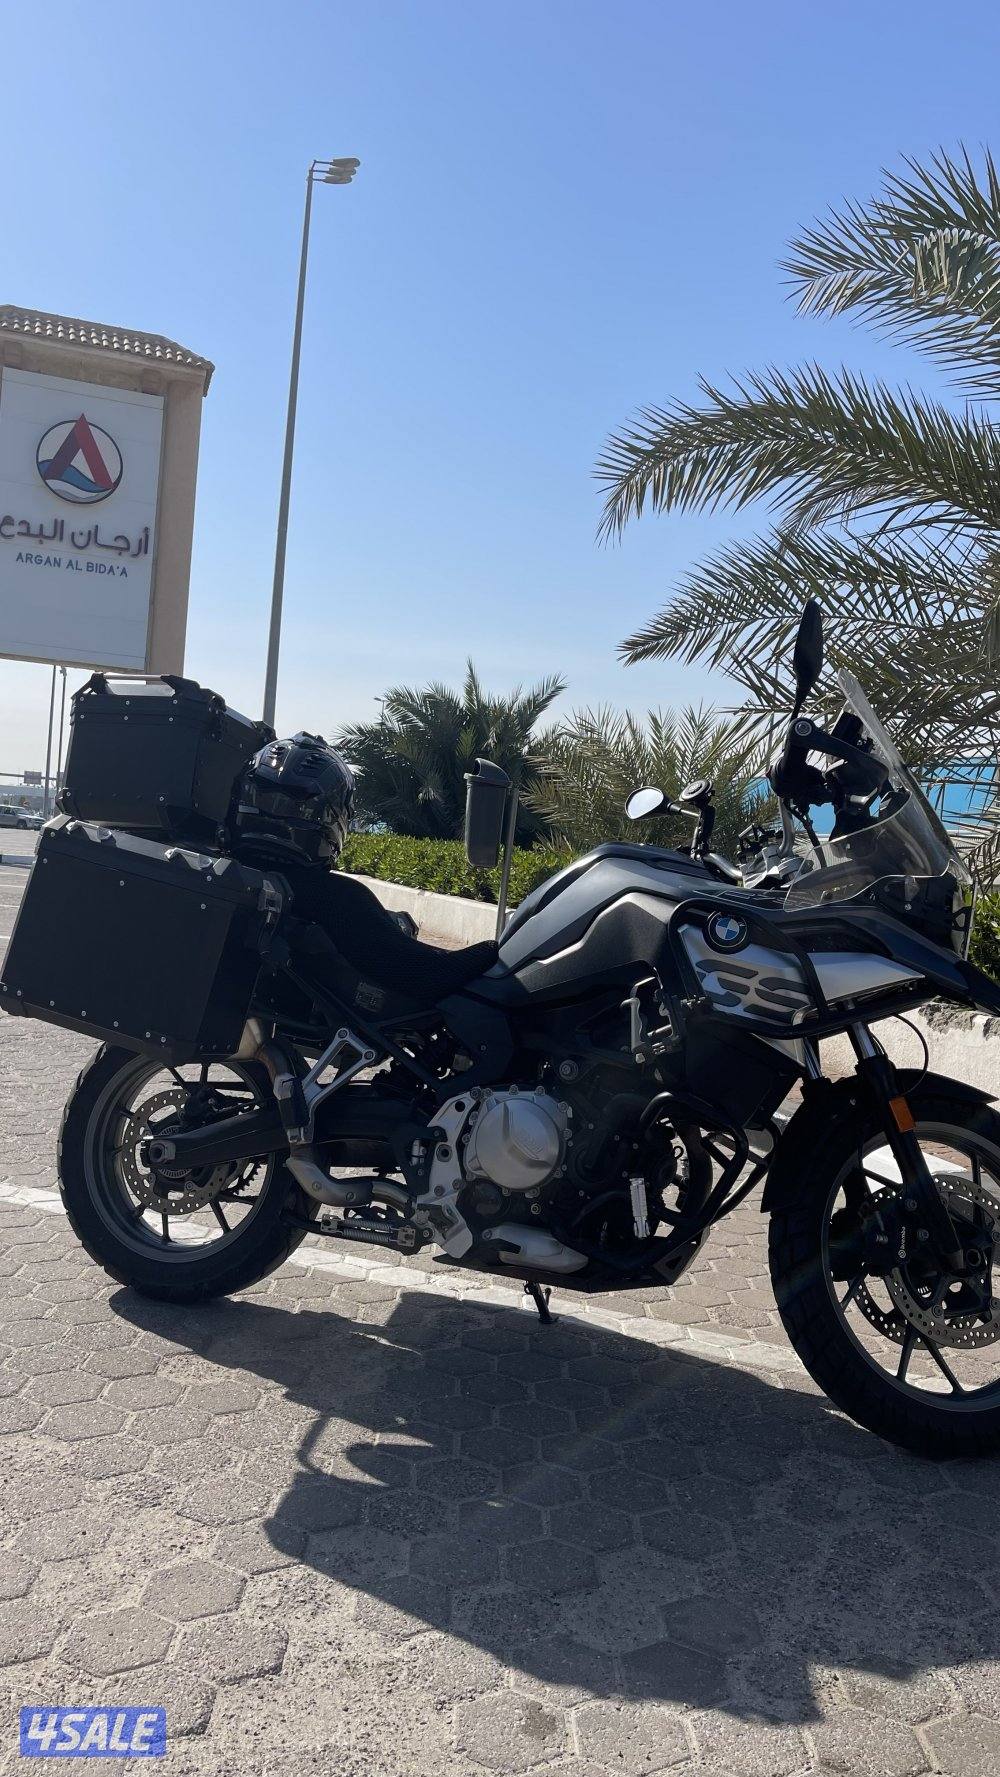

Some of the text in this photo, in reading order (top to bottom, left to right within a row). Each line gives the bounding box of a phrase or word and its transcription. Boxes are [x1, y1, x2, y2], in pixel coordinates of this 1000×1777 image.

[70, 524, 150, 558] أرجان
[16, 552, 129, 578] ARGAN AL BIDA'A
